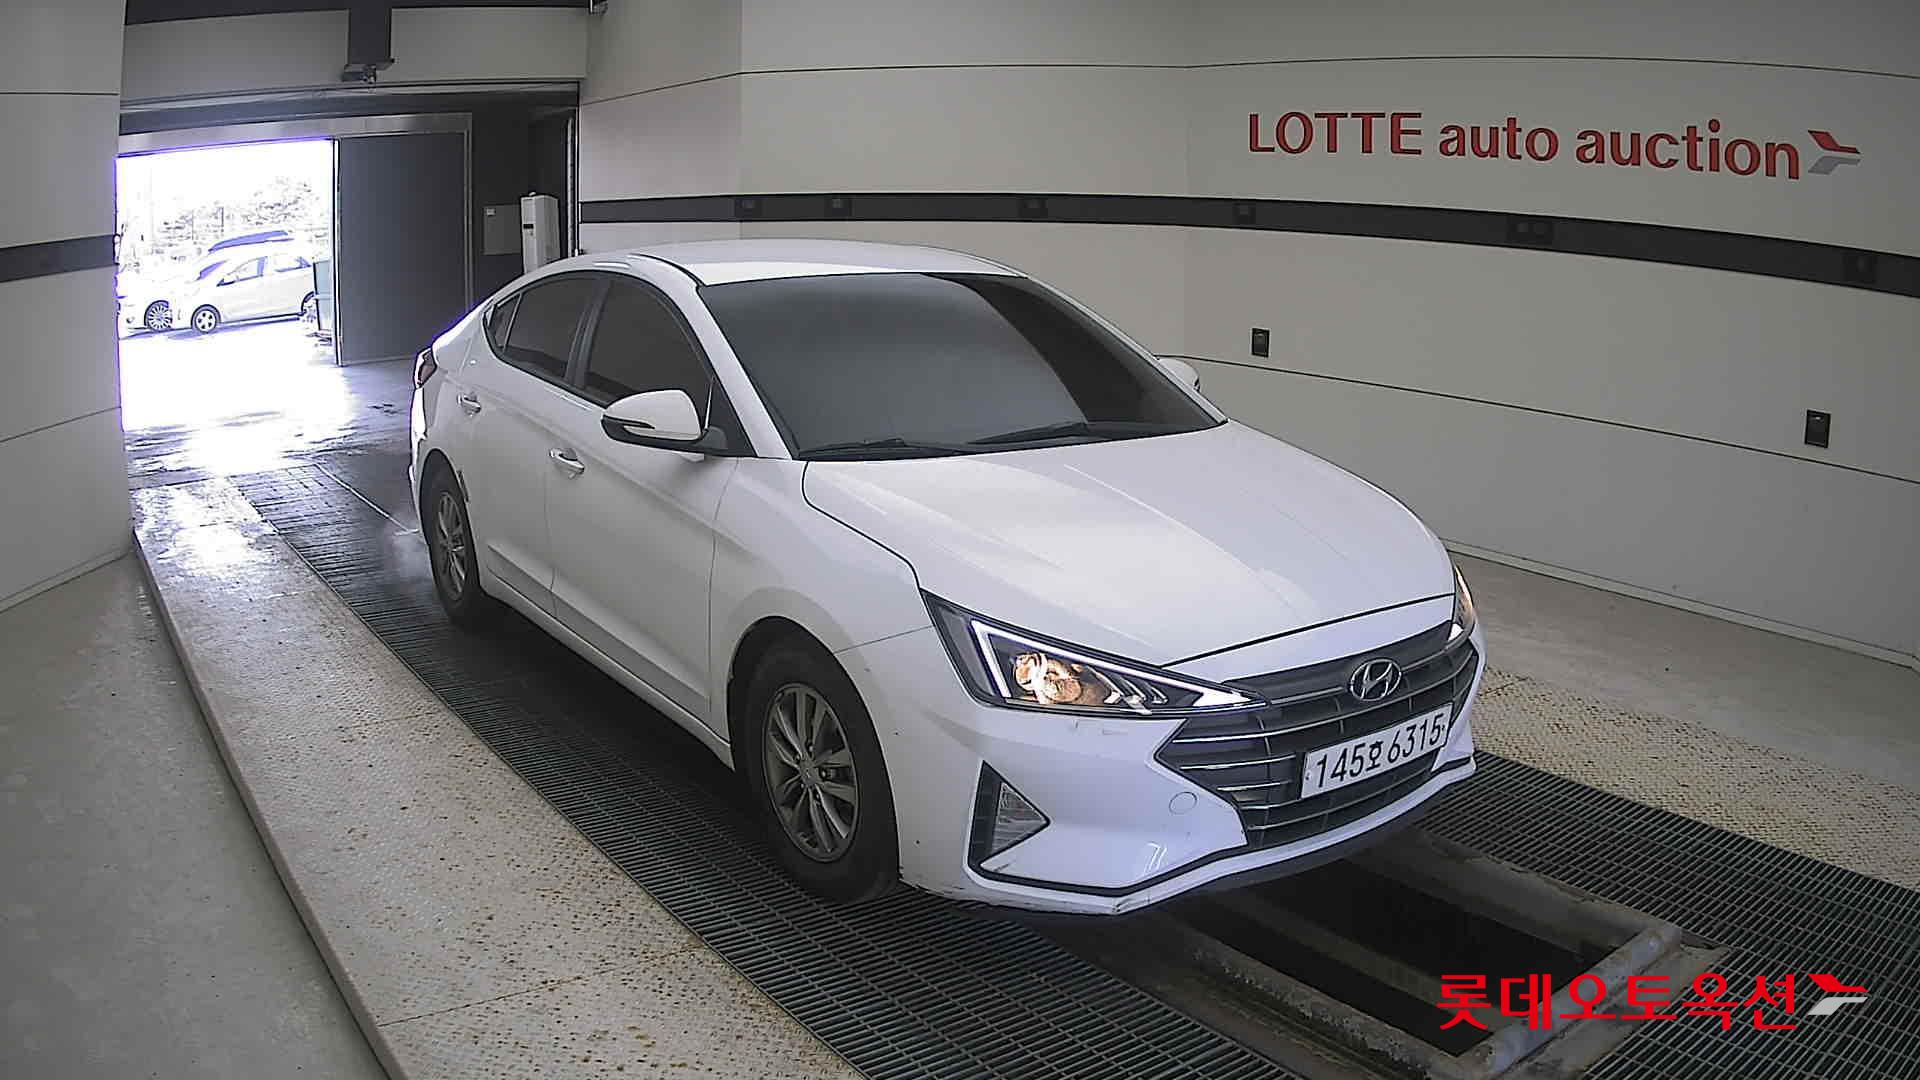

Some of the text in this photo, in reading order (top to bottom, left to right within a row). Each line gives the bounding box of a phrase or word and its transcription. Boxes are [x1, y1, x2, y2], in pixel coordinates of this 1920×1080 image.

[1249, 112, 1799, 179] LOTTE auto auction
[1387, 712, 1444, 764] 6315
